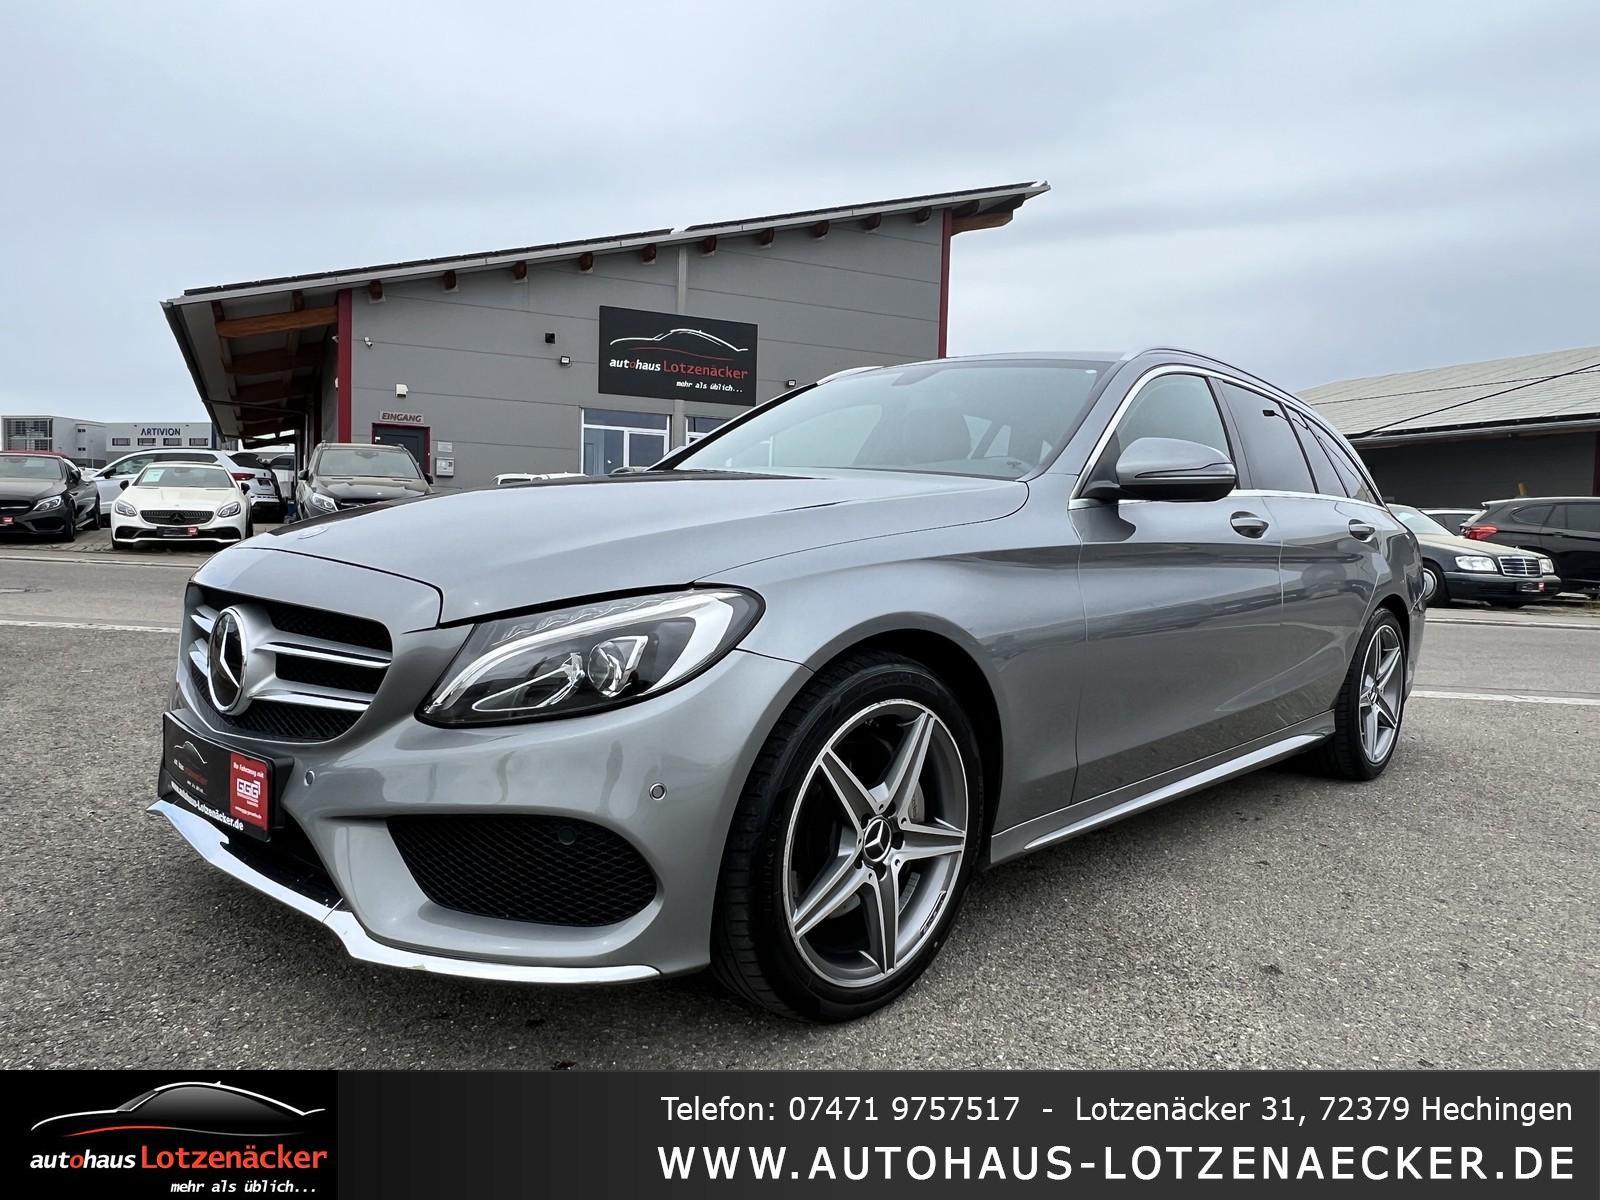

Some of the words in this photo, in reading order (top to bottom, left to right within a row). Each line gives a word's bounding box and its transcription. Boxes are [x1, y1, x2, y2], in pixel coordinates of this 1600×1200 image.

[609, 358, 661, 372] autohaus
[663, 360, 749, 380] Lotzenäcker
[676, 380, 693, 388] mehr
[695, 381, 707, 390] als
[710, 382, 743, 393] üblich...
[382, 412, 422, 422] EINGANG
[140, 427, 181, 436] ARTIVION
